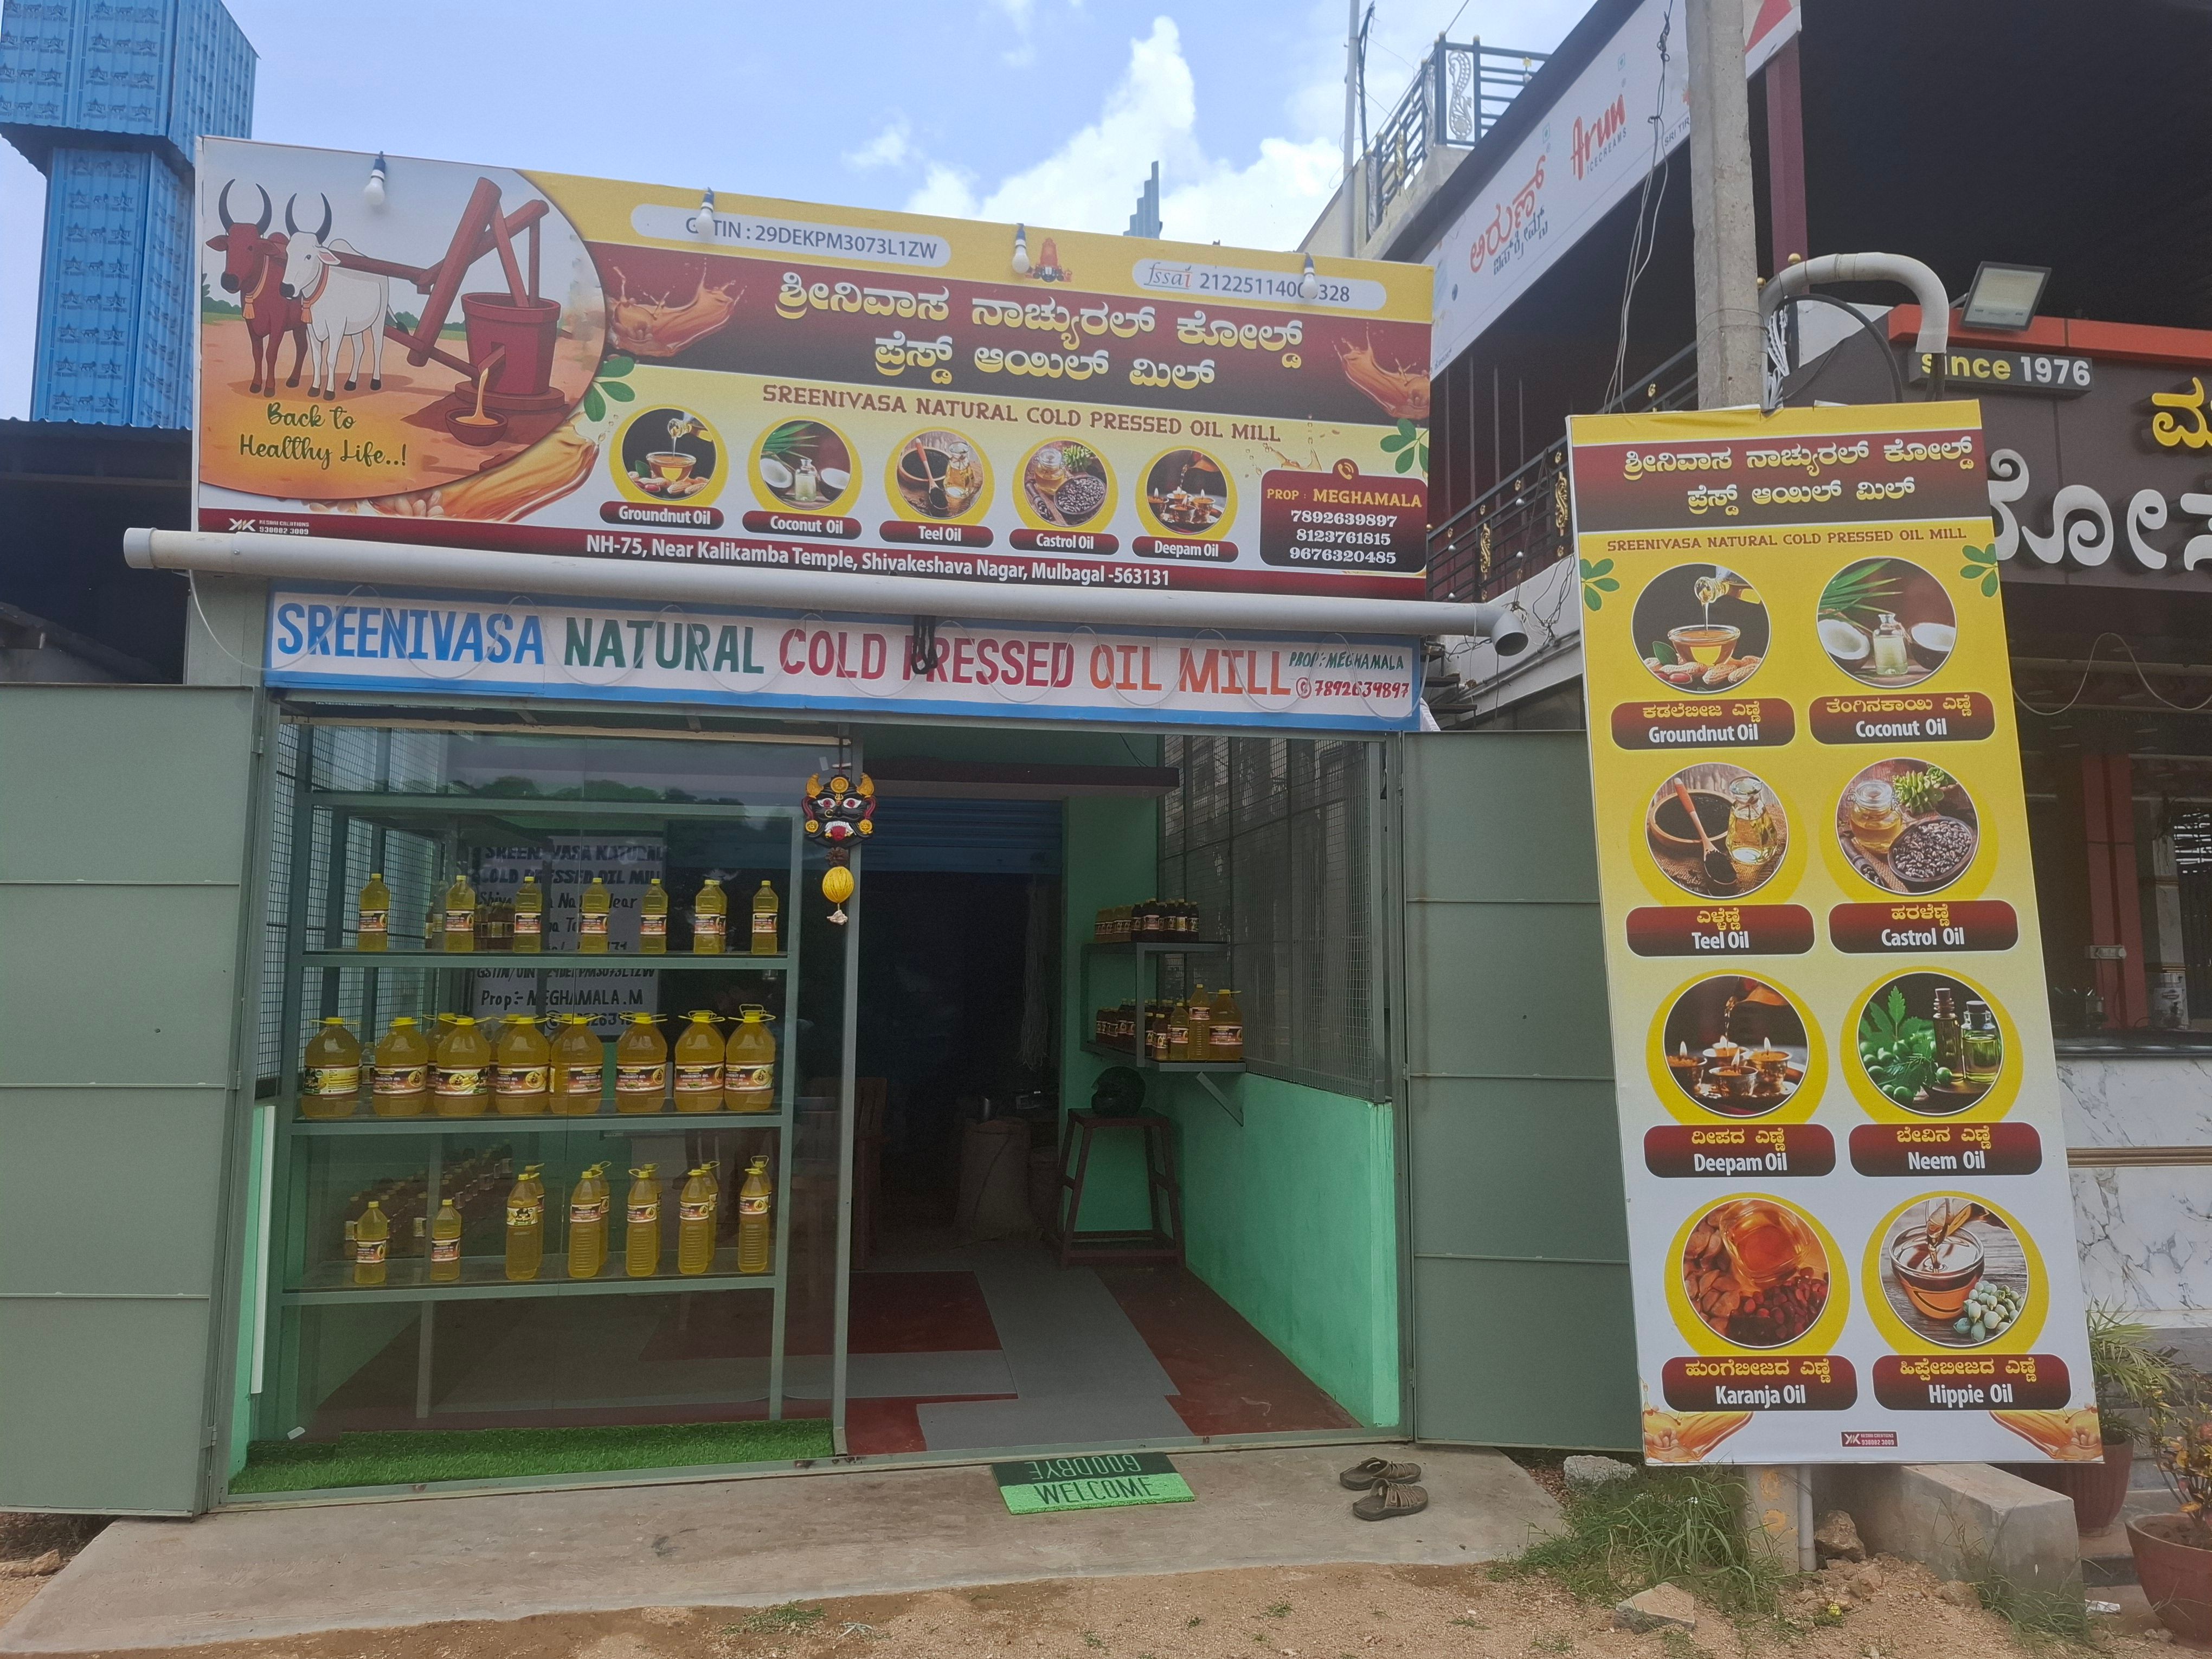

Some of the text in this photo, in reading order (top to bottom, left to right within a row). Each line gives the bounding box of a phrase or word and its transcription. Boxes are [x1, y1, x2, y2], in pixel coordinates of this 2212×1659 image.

[1570, 94, 1625, 181] Arun
[686, 217, 742, 239] GTIN
[755, 225, 937, 259] 29DEKPM3073L1ZW
[775, 272, 1302, 369] ಶ್ರೀನಿವಾಸ ನಾಚ್ಯುರಲ್ ಕೋಲ್ಡ್
[875, 331, 1215, 389] ಪ್ರೆಸ್ಡ್ ಆಯಿಲ್ ಮಿಲ್
[1921, 353, 2090, 386] snce 1976
[267, 402, 357, 429] Back to
[763, 384, 1281, 443] SREENIVASA NATURAL COLD PRESSED OIL MILL
[240, 434, 332, 470] Healthy
[1623, 436, 1973, 480] ಶ್ರೀನಿವಾಸ ನಾಚ್ಯುರಲ್ ಕೋಲ್ಡ್
[1267, 488, 1299, 500] PROP
[1313, 488, 1423, 507] MEGHAMALA
[1688, 477, 1915, 516] ಪ್ರೆಸ್ಡ್ ಆಯಿಲ್ ಮಿಲ್
[619, 505, 711, 525] Groundnut Oil
[770, 516, 844, 534] Coconut Oil
[1291, 510, 1397, 527] 7892639897
[918, 525, 962, 542] Teel Oil
[1036, 533, 1094, 550] Castrol Oil
[1296, 529, 1391, 545] 8123761815
[1607, 528, 1967, 552] SREENIVASA NATURAL COLD PRESSED OIL MILL
[587, 535, 1169, 586] NH-75, Near Kalikamba Temple, Shivakeshava Nagar, Mulbagal -563131
[1154, 541, 1219, 558] Deepam Oil
[1289, 547, 1396, 564] 9676320485
[276, 602, 544, 665] SREENIVASA
[564, 617, 764, 674] NATURAL
[780, 628, 886, 680] COLD
[1089, 644, 1162, 691] OIL
[1179, 647, 1291, 695] MILL
[1325, 651, 1404, 671] MEGHAMALA
[1315, 680, 1410, 698] 7892639897
[1643, 700, 1761, 723] ಕಡಲೆಬೀಜ ಎಣ್ಣೆ
[1826, 694, 1972, 717] ತೆಂಗಿನಕಾಯಿ ಎಣ್ಣೆ
[1649, 723, 1759, 743] Groundnut Oil
[1856, 718, 1947, 738] Coconut Oil
[1692, 931, 1750, 949] Teel Oil
[1881, 927, 1965, 946] Castrol Oil
[1692, 1127, 1785, 1152] ದೀಪದ ಎಣ್ಣೆ
[1897, 1125, 1991, 1149] ಬೇವಿನ ಎಣ್ಣೆ
[1694, 1153, 1787, 1175] Deepam Oil
[1908, 1150, 1985, 1169] Neem Oil
[1685, 1358, 1831, 1383] ಹುಂಗೆಬೀಜದ ಎಣ್ಣೆ
[2005, 1357, 2037, 1382] ಎಣ್ಣೆ
[1715, 1385, 1806, 1409] Karanja Oil
[1928, 1384, 2013, 1408] Hippie Oil
[1024, 1454, 1142, 1480] GOODBYE
[1033, 1477, 1160, 1504] WELCOME
